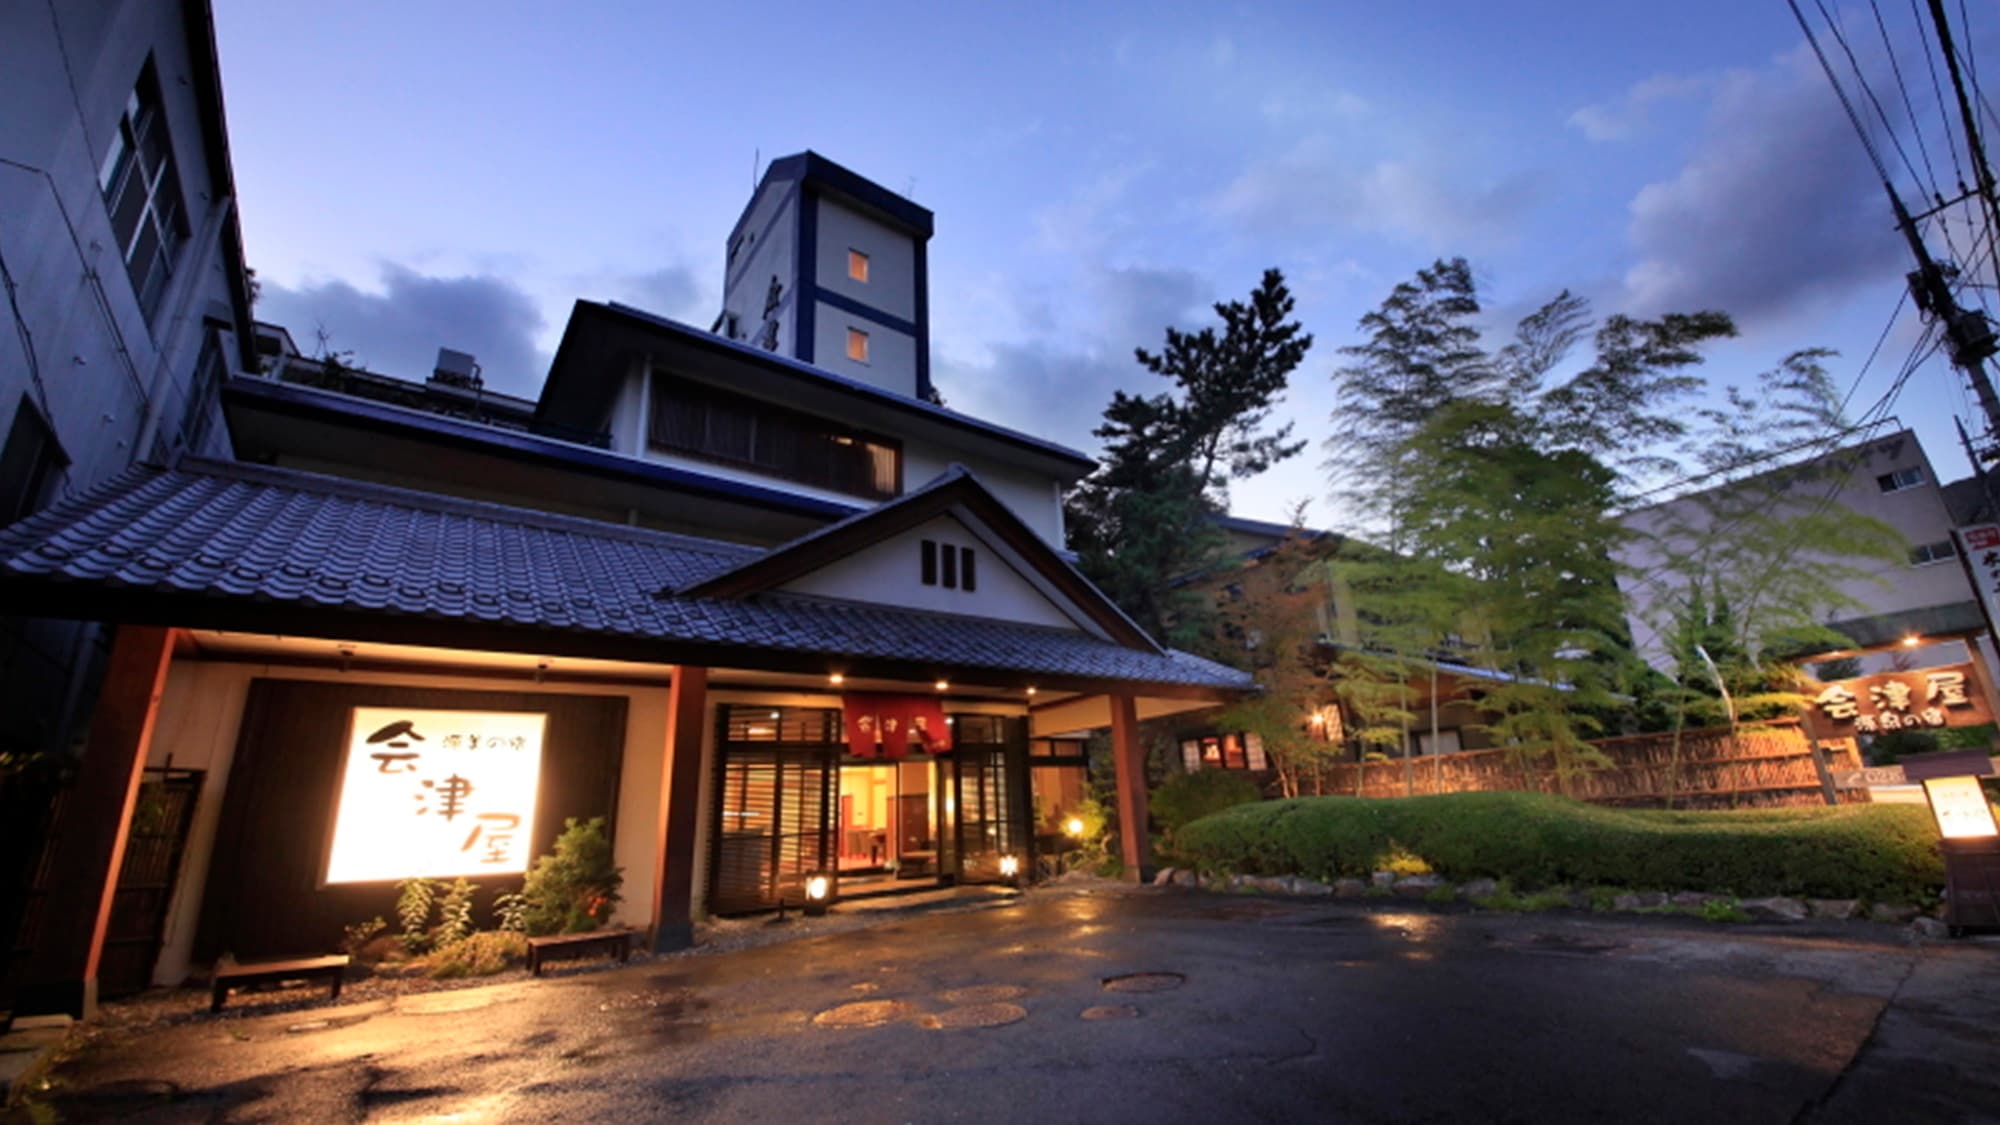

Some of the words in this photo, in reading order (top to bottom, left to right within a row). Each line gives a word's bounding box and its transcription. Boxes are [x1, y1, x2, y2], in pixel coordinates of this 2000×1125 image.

[1814, 671, 1969, 719] 会津屋
[366, 720, 521, 864] 会津屋
